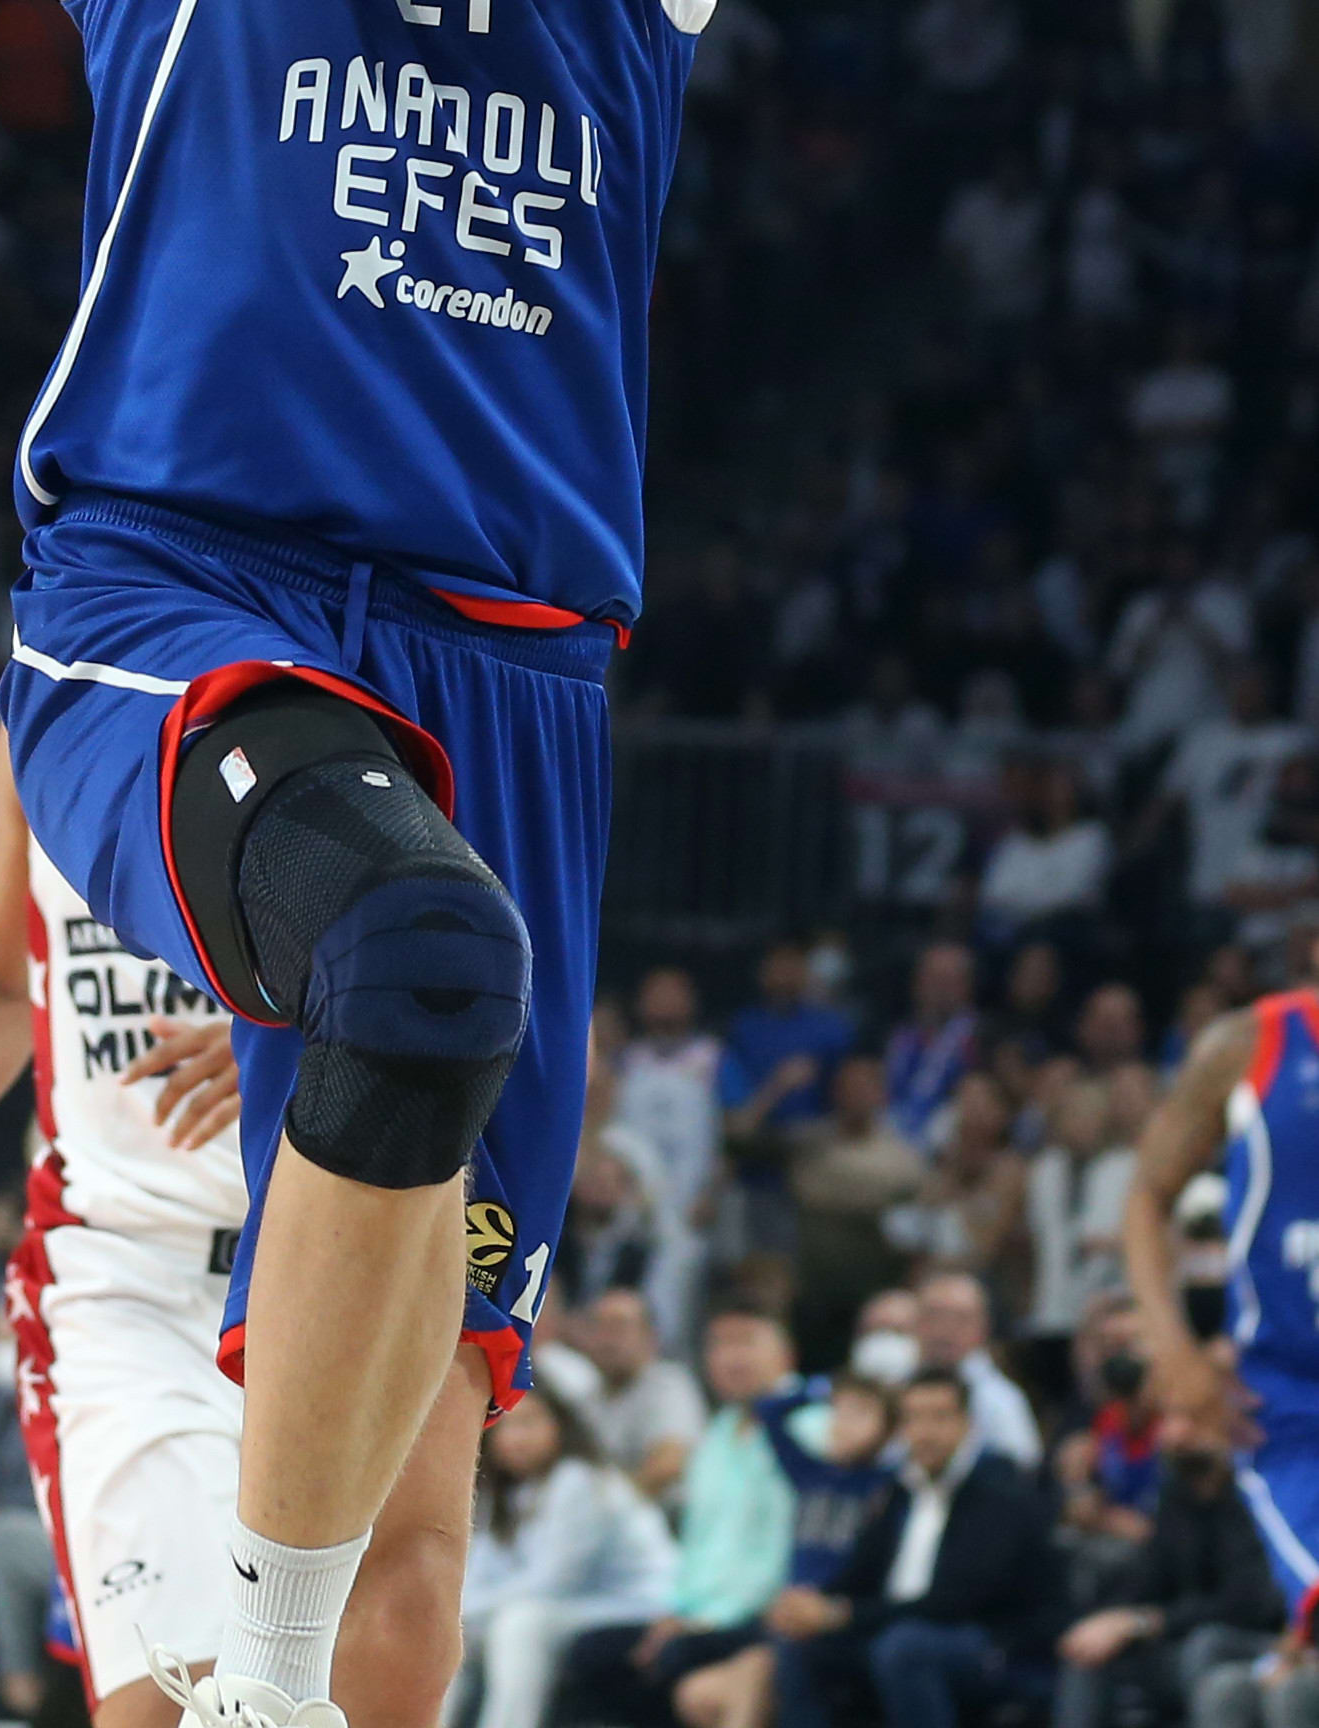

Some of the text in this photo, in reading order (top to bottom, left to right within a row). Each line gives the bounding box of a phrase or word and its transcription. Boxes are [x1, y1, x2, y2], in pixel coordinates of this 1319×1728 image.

[333, 143, 566, 270] EFES
[396, 274, 553, 336] corendon
[466, 1265, 497, 1285] KISH
